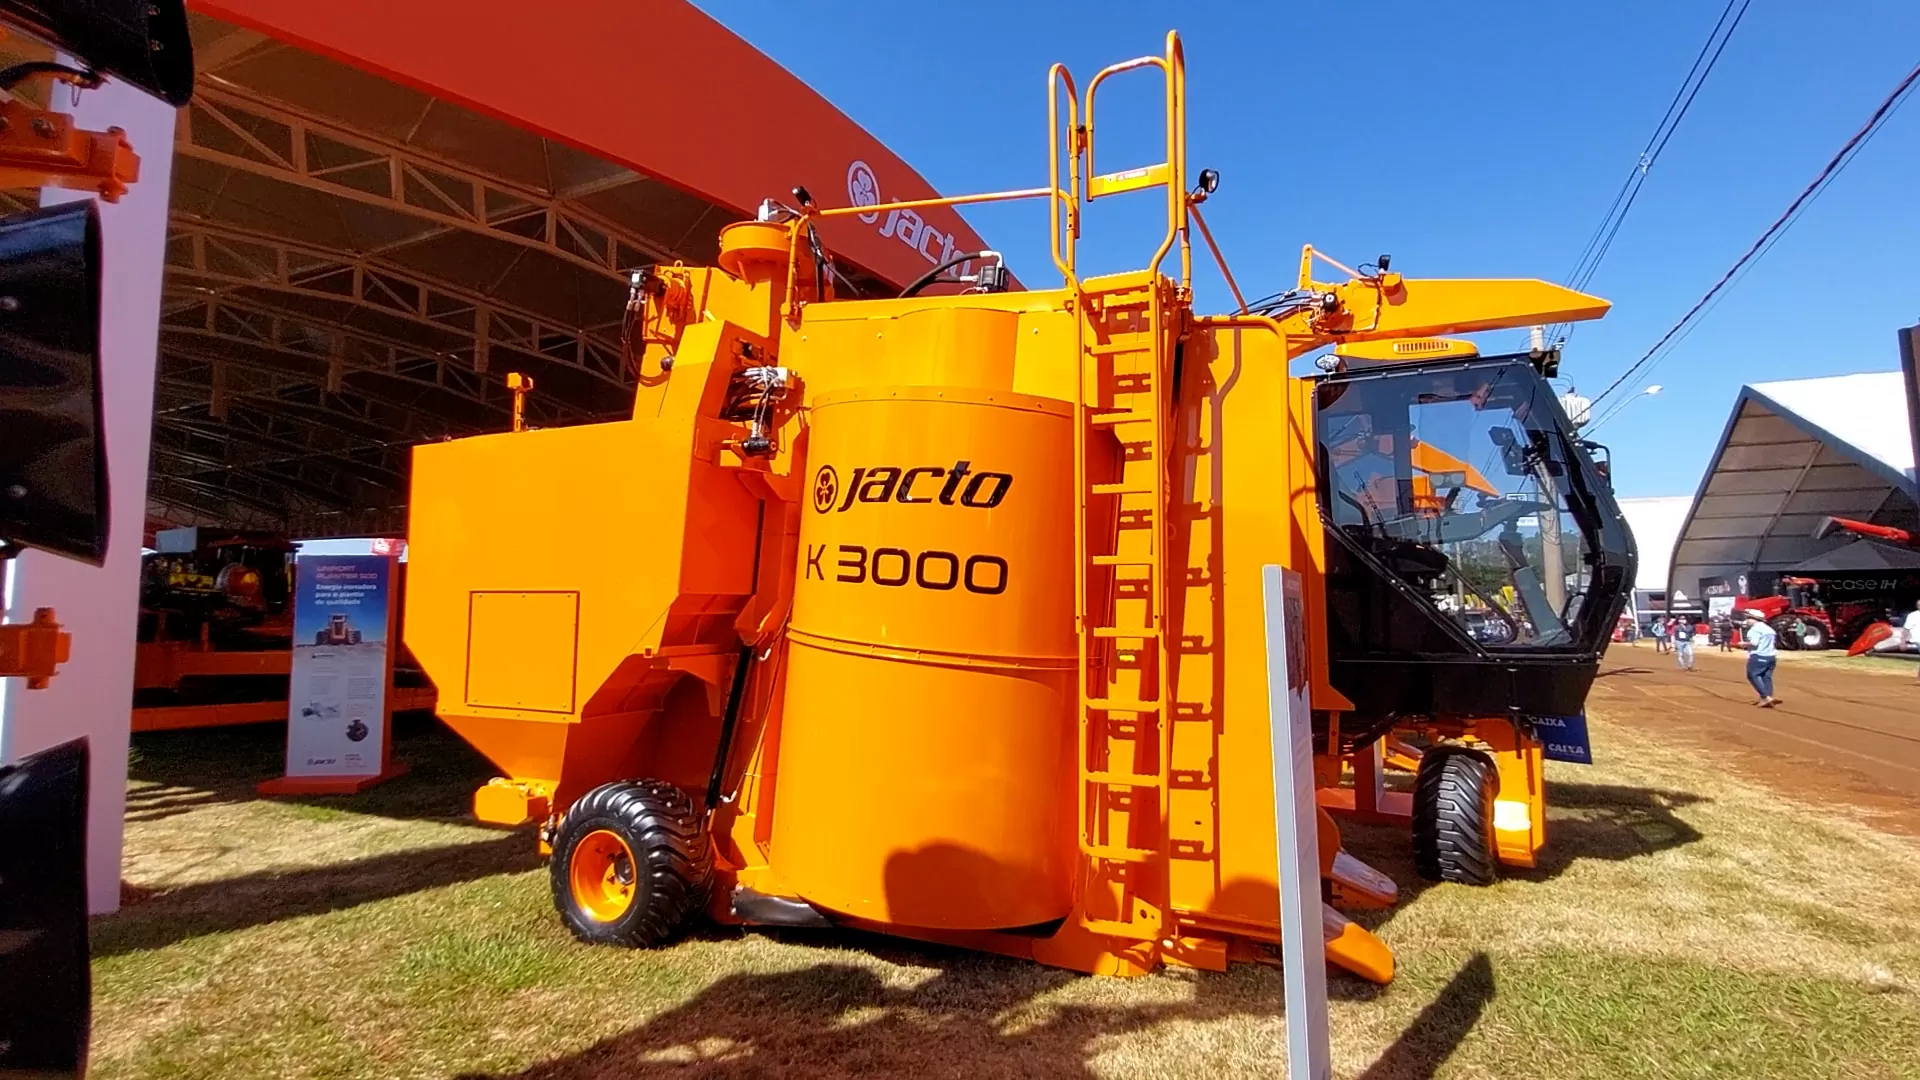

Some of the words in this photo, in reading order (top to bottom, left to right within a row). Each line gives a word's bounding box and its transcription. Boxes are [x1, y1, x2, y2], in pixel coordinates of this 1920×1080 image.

[879, 196, 972, 279] jacto
[837, 460, 1013, 513] jacto
[806, 544, 826, 581] K
[836, 544, 1009, 595] 3000
[1530, 716, 1566, 728] CAIXA
[1548, 743, 1584, 754] CAIXA
